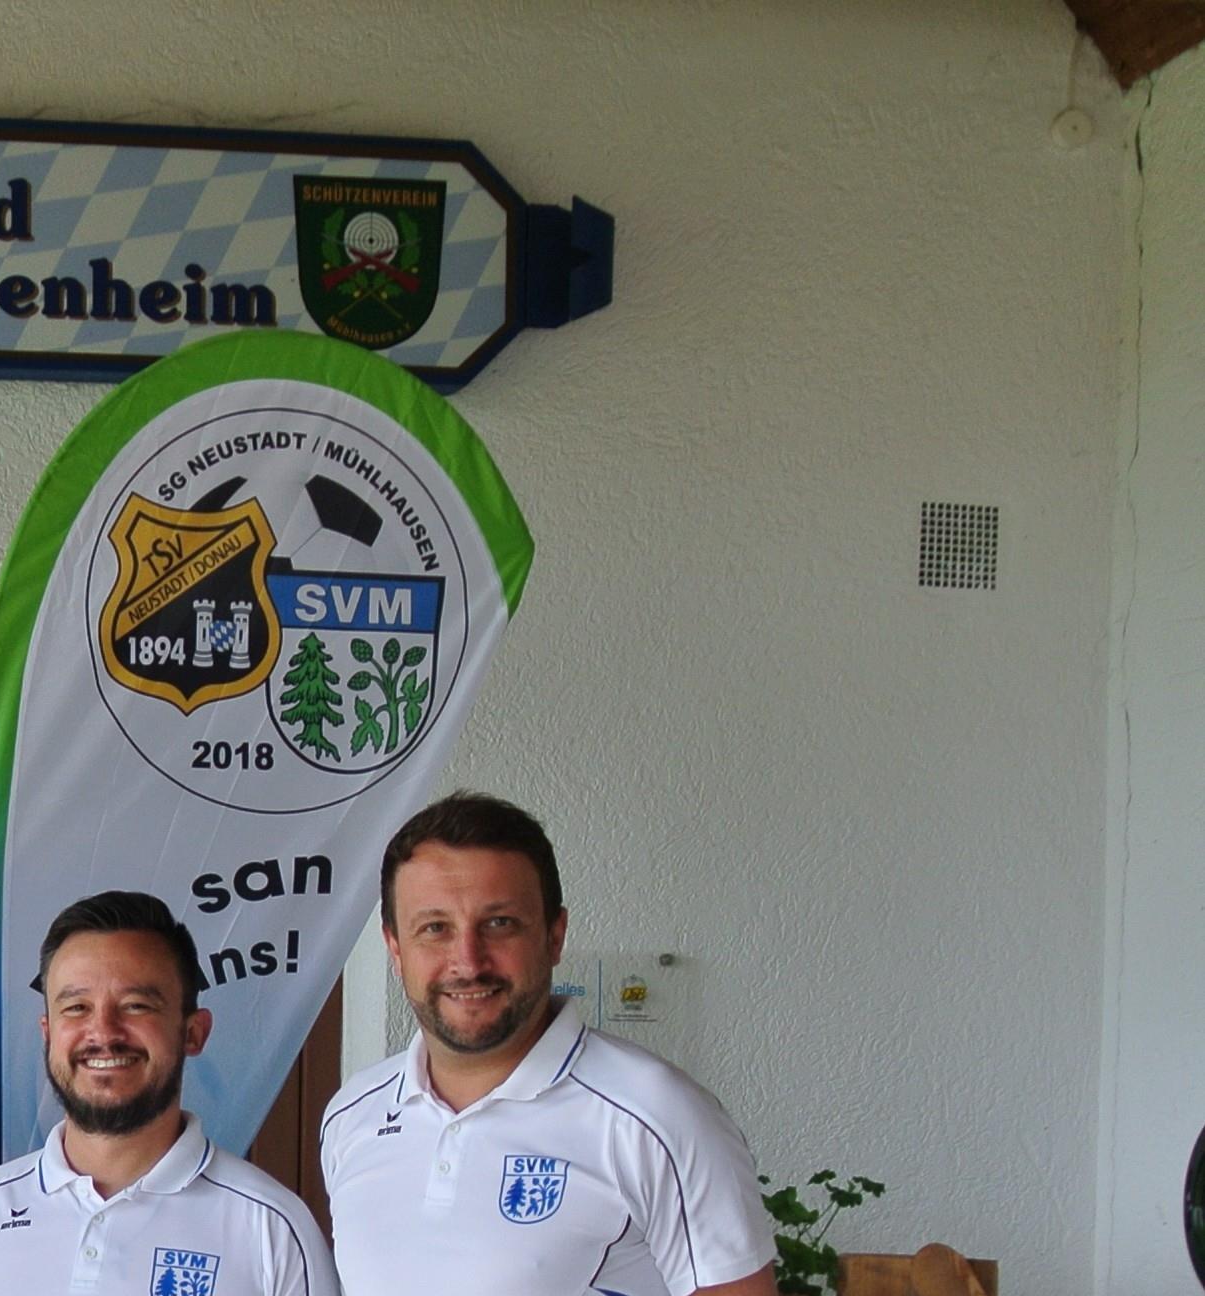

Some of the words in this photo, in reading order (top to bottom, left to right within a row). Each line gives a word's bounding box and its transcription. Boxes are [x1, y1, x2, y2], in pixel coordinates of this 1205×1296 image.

[302, 183, 439, 208] SCHÜTZENVEREIN
[157, 468, 188, 502] SG
[187, 431, 307, 477] NEUSTADT
[323, 442, 440, 573] MÜHLHAUSEN
[142, 533, 185, 578] TSV
[128, 574, 189, 625] NEUSTADT
[193, 534, 243, 577] DONAU
[295, 582, 414, 626] SVM
[128, 635, 187, 667] 1894
[191, 740, 275, 770] 2018
[191, 854, 333, 914] san
[377, 1124, 403, 1137] erima
[513, 1158, 557, 1174] SVM
[0, 1218, 32, 1231] erima
[162, 1250, 208, 1269] SVM
